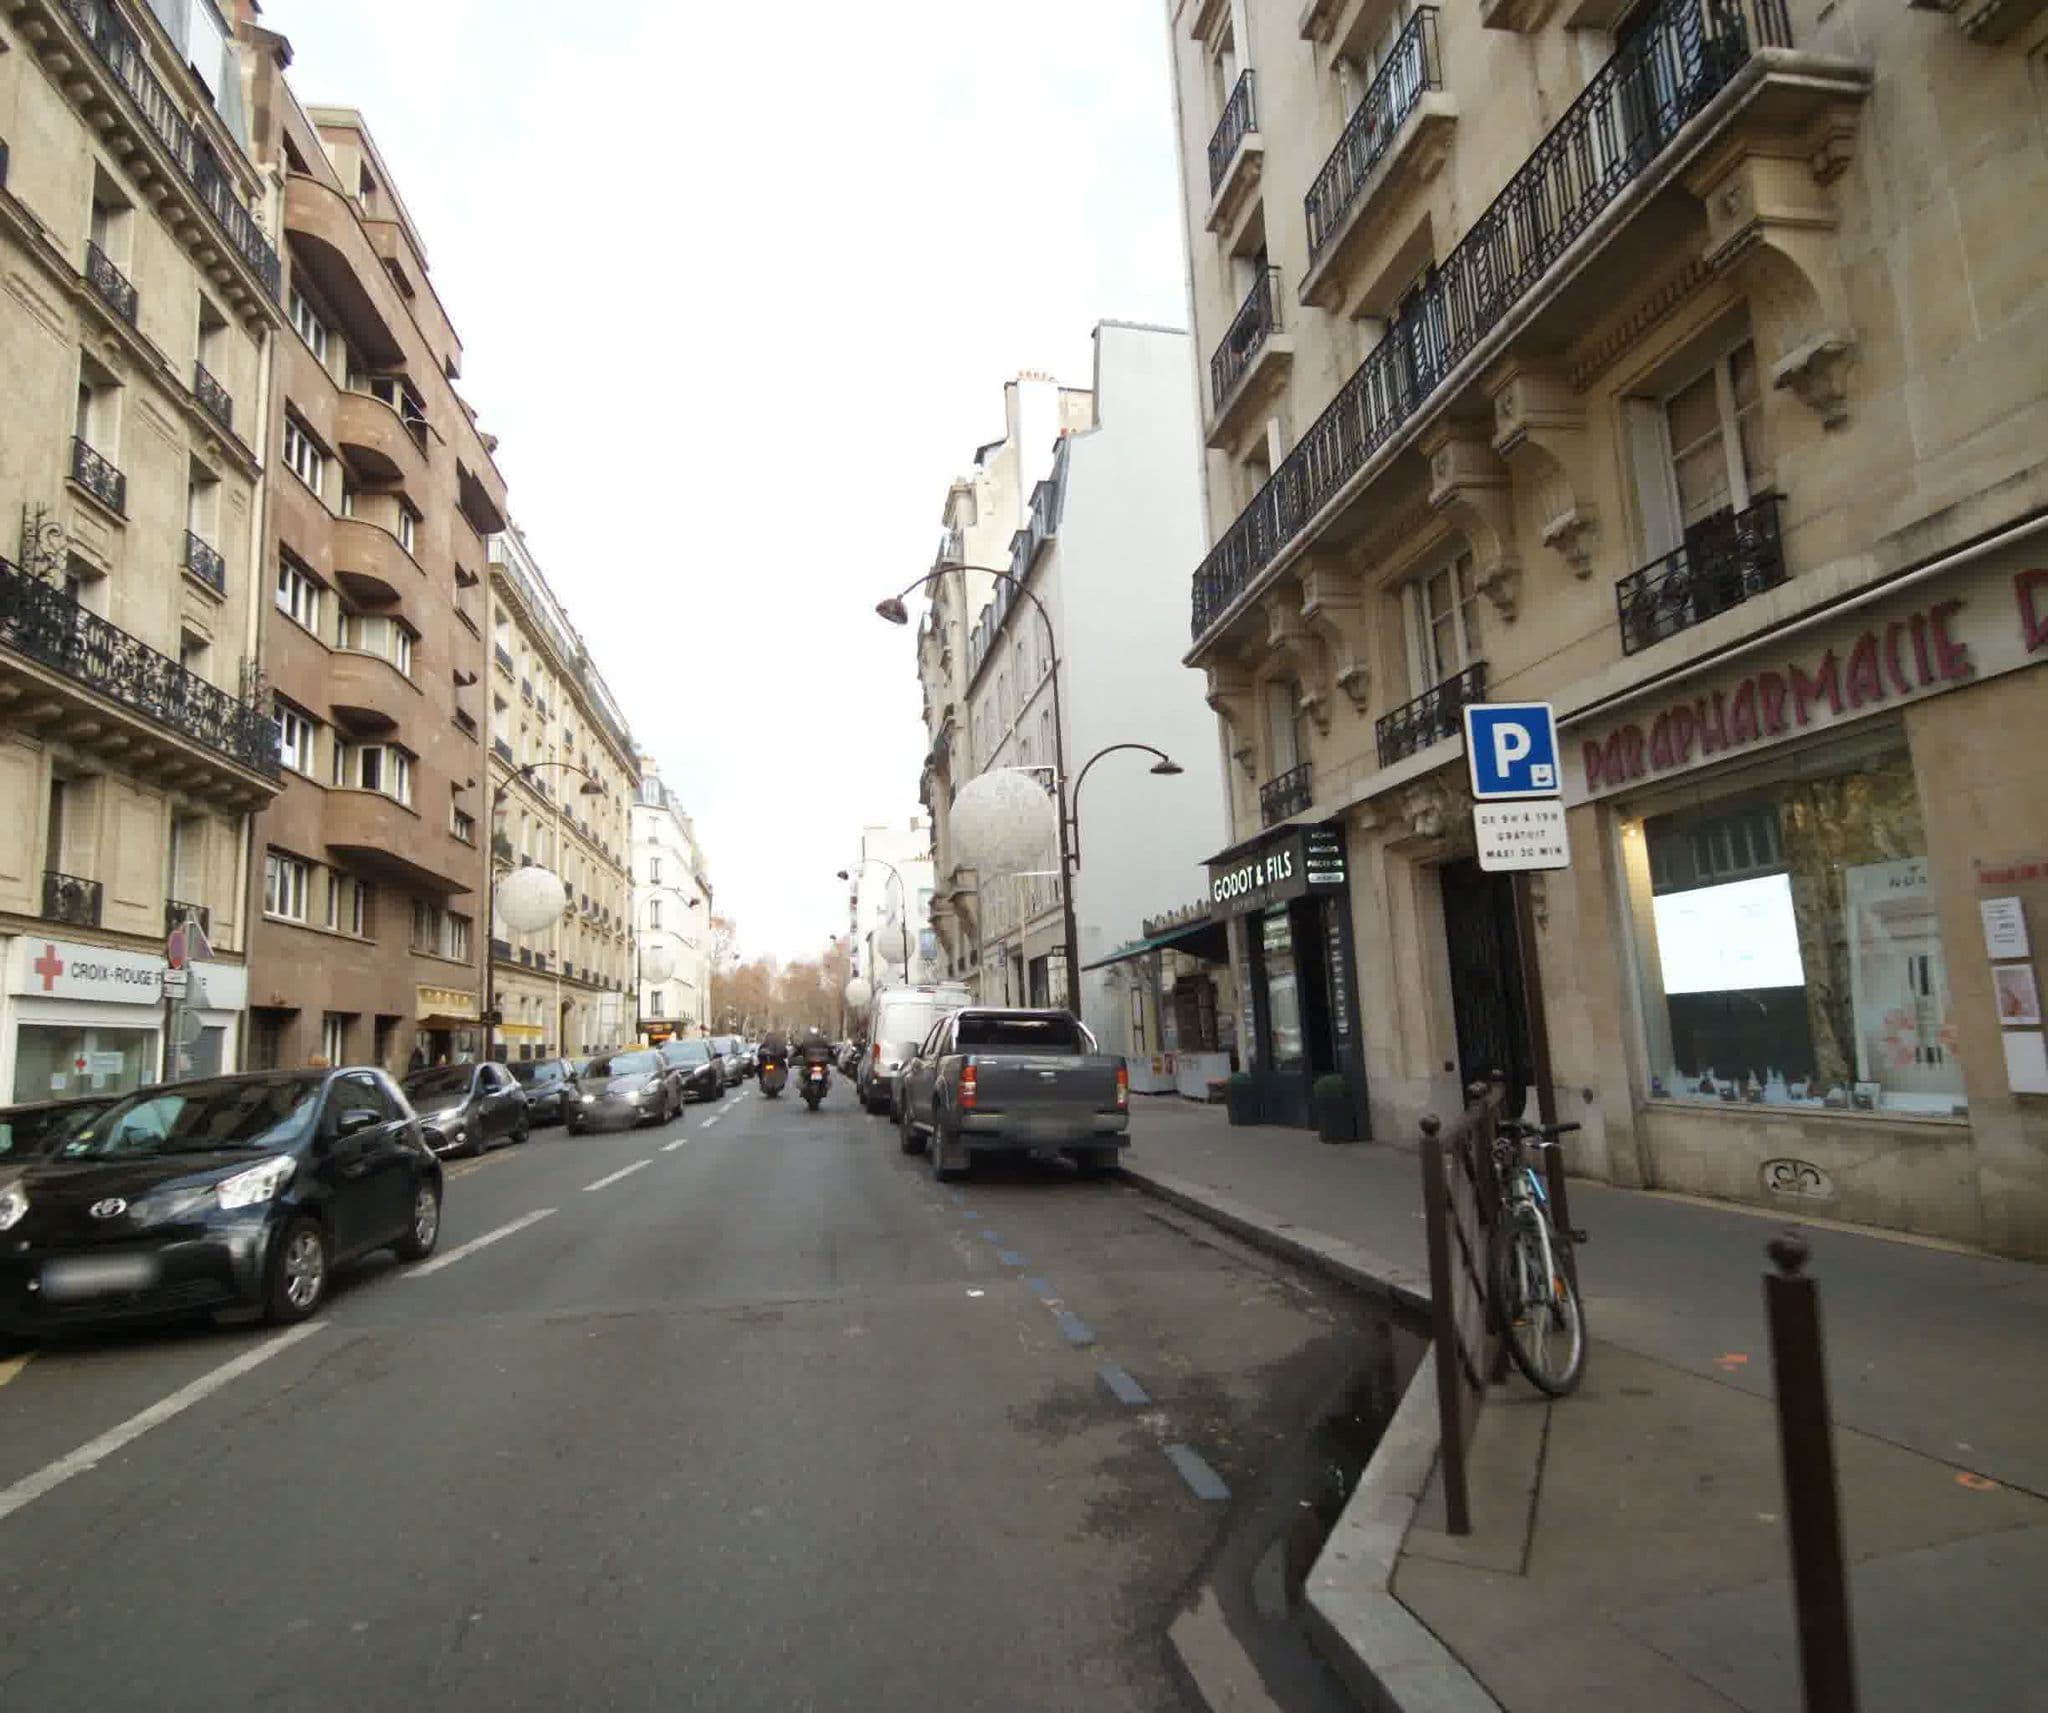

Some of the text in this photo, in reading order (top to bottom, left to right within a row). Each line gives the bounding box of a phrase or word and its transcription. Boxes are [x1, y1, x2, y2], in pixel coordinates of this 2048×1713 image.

[1582, 598, 1976, 794] PARAPHARMACIE
[1492, 722, 1531, 778] P
[1498, 829, 1546, 841] GRATUIT
[1214, 850, 1292, 903] GODOT & FILS
